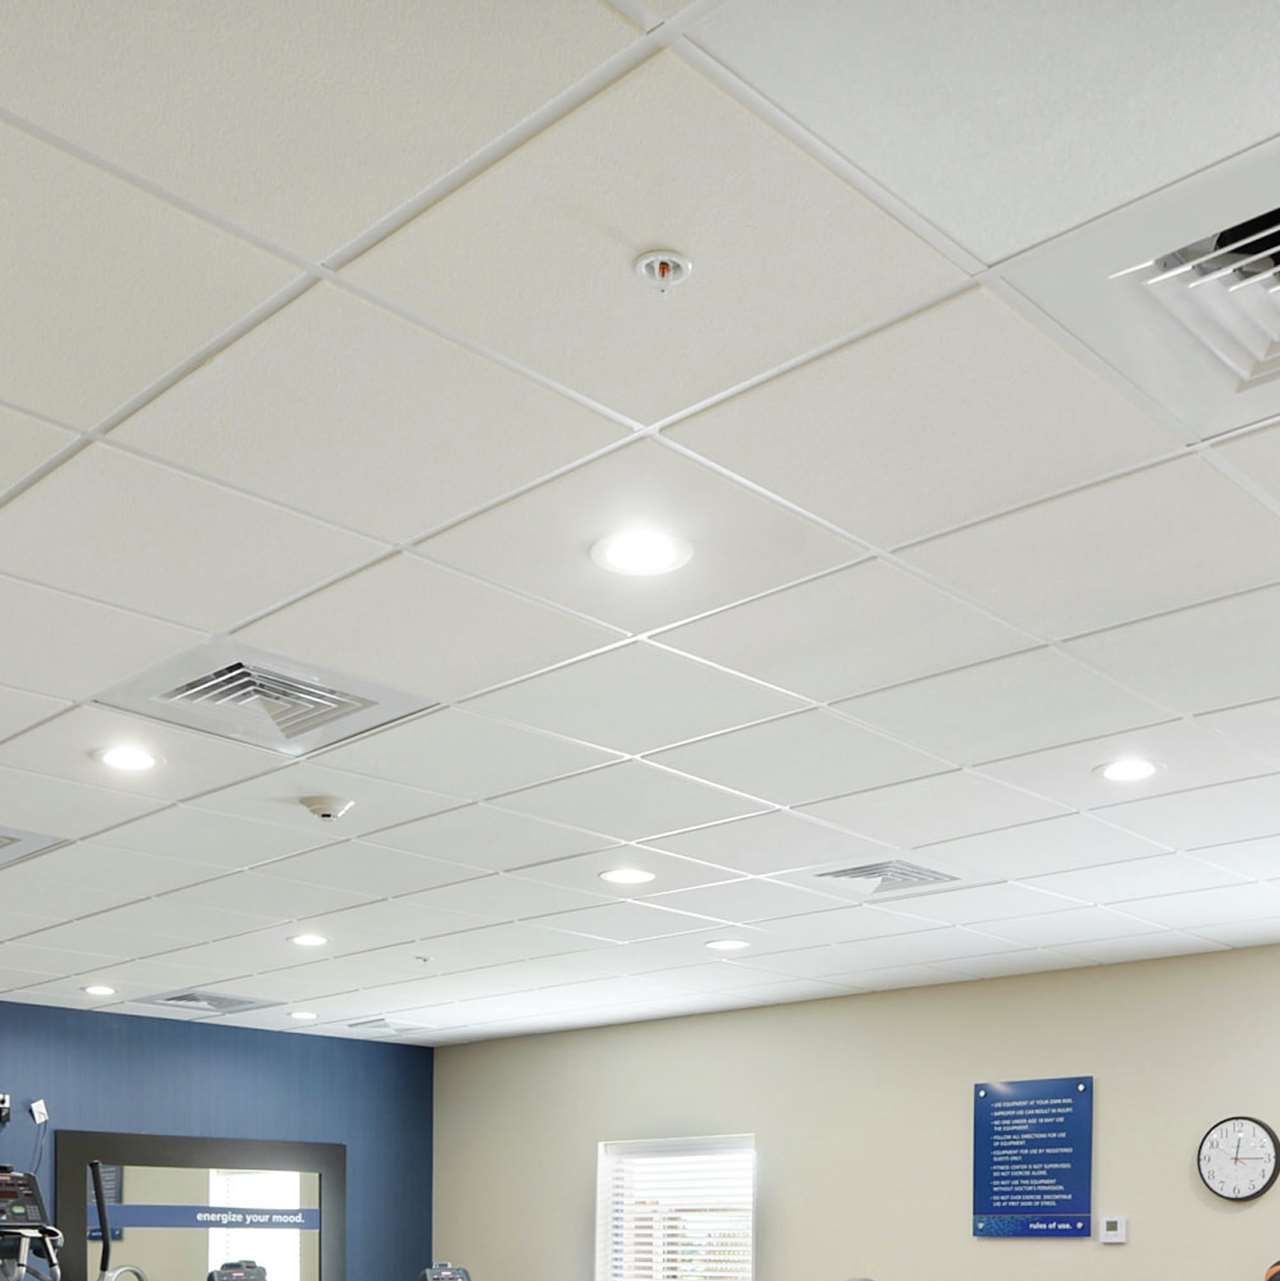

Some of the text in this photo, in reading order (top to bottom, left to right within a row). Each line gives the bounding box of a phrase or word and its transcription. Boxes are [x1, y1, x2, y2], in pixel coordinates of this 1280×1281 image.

[197, 1211, 305, 1224] energize your mood.
[1029, 1221, 1047, 1230] rules
[1048, 1221, 1057, 1230] of
